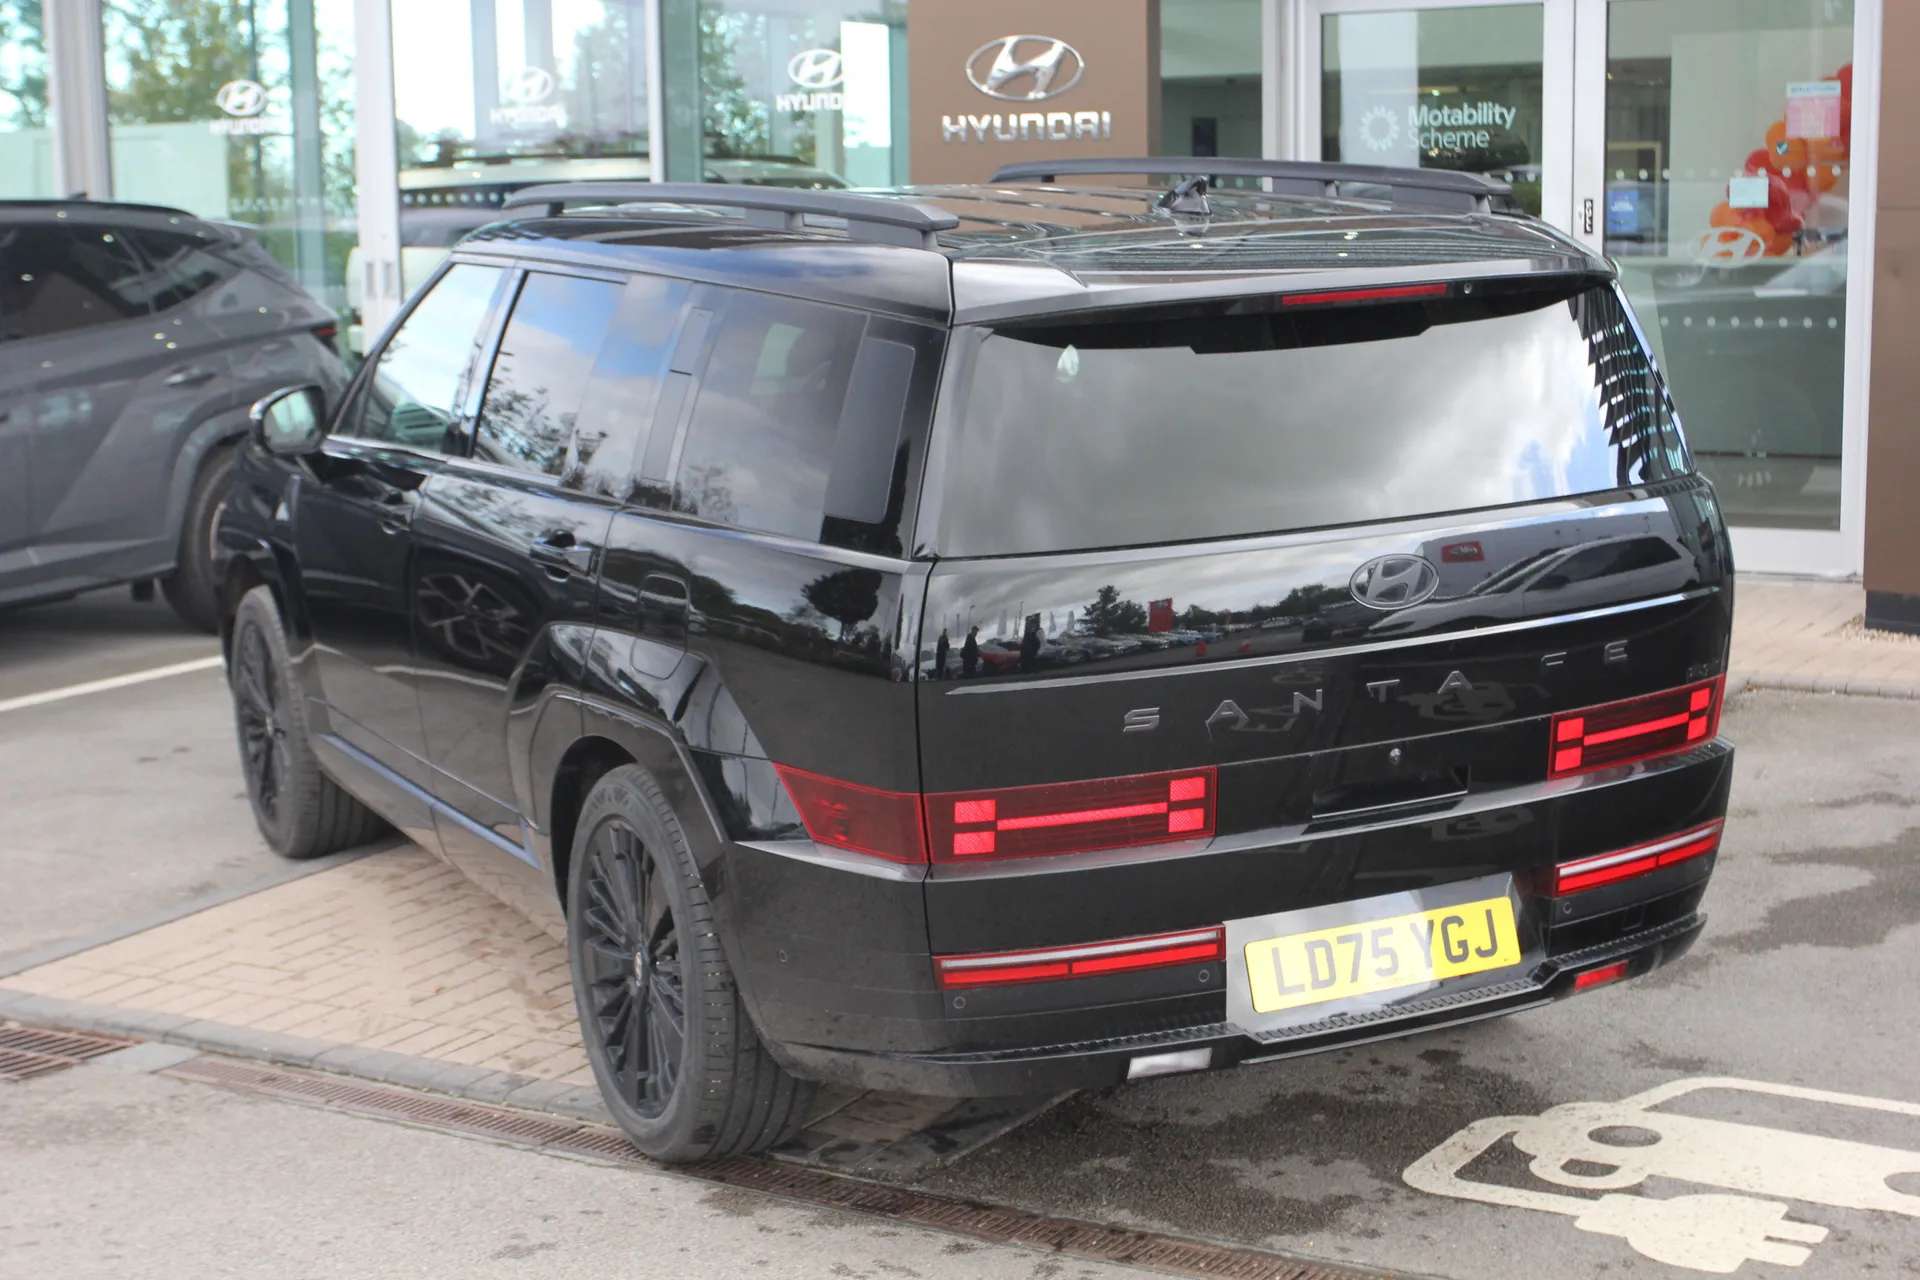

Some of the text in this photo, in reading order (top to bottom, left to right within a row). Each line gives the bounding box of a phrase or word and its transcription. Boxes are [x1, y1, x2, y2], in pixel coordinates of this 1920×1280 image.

[776, 93, 844, 112] HYUND
[1408, 101, 1517, 131] Motability
[942, 110, 1112, 143] HYUNDAI
[1408, 127, 1490, 150] Scheme
[1123, 640, 1628, 738] SANTA FE
[1271, 908, 1498, 997] LD75 YGJ
